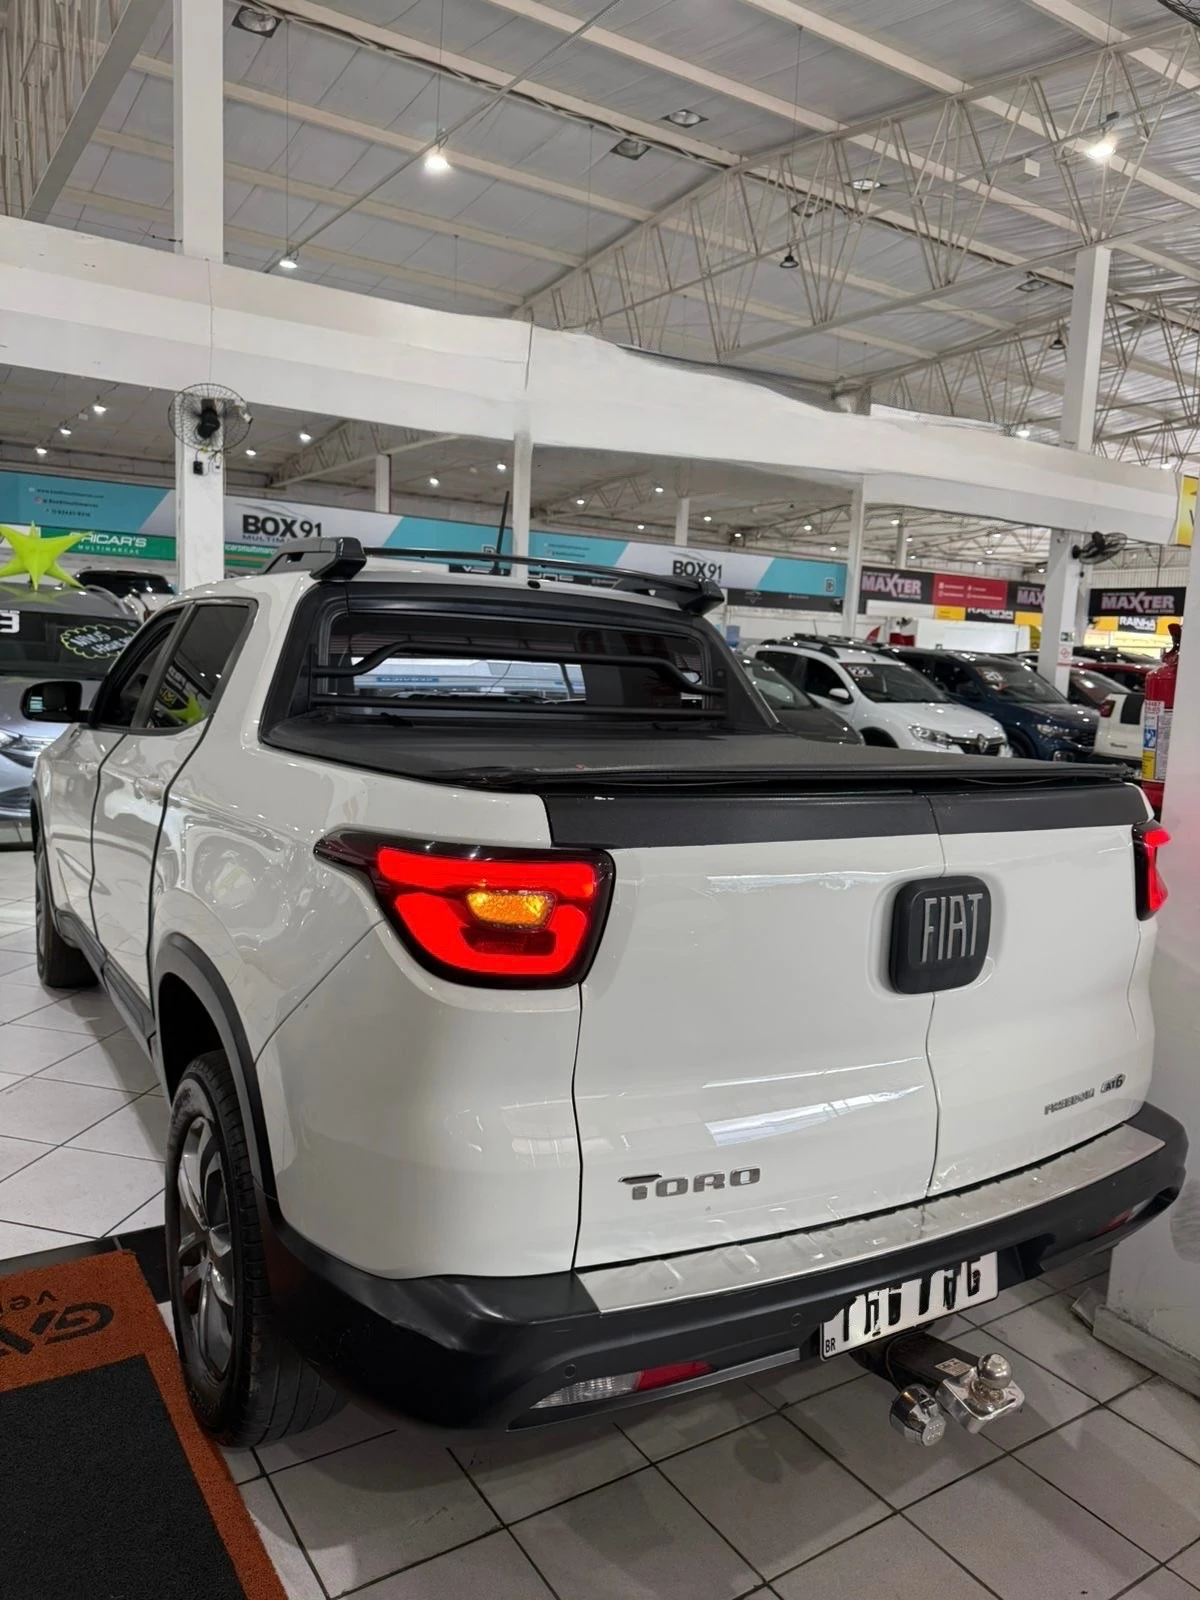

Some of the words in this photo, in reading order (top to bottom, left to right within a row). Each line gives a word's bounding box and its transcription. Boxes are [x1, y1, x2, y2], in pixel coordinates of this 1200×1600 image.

[243, 514, 297, 538] BOX
[299, 521, 322, 538] 91
[673, 560, 706, 577] BOX
[861, 573, 922, 598] MAXTER
[1101, 592, 1175, 613] MAXTER
[921, 893, 984, 963] FIAT
[618, 1168, 761, 1200] TORO
[825, 1338, 836, 1353] BR
